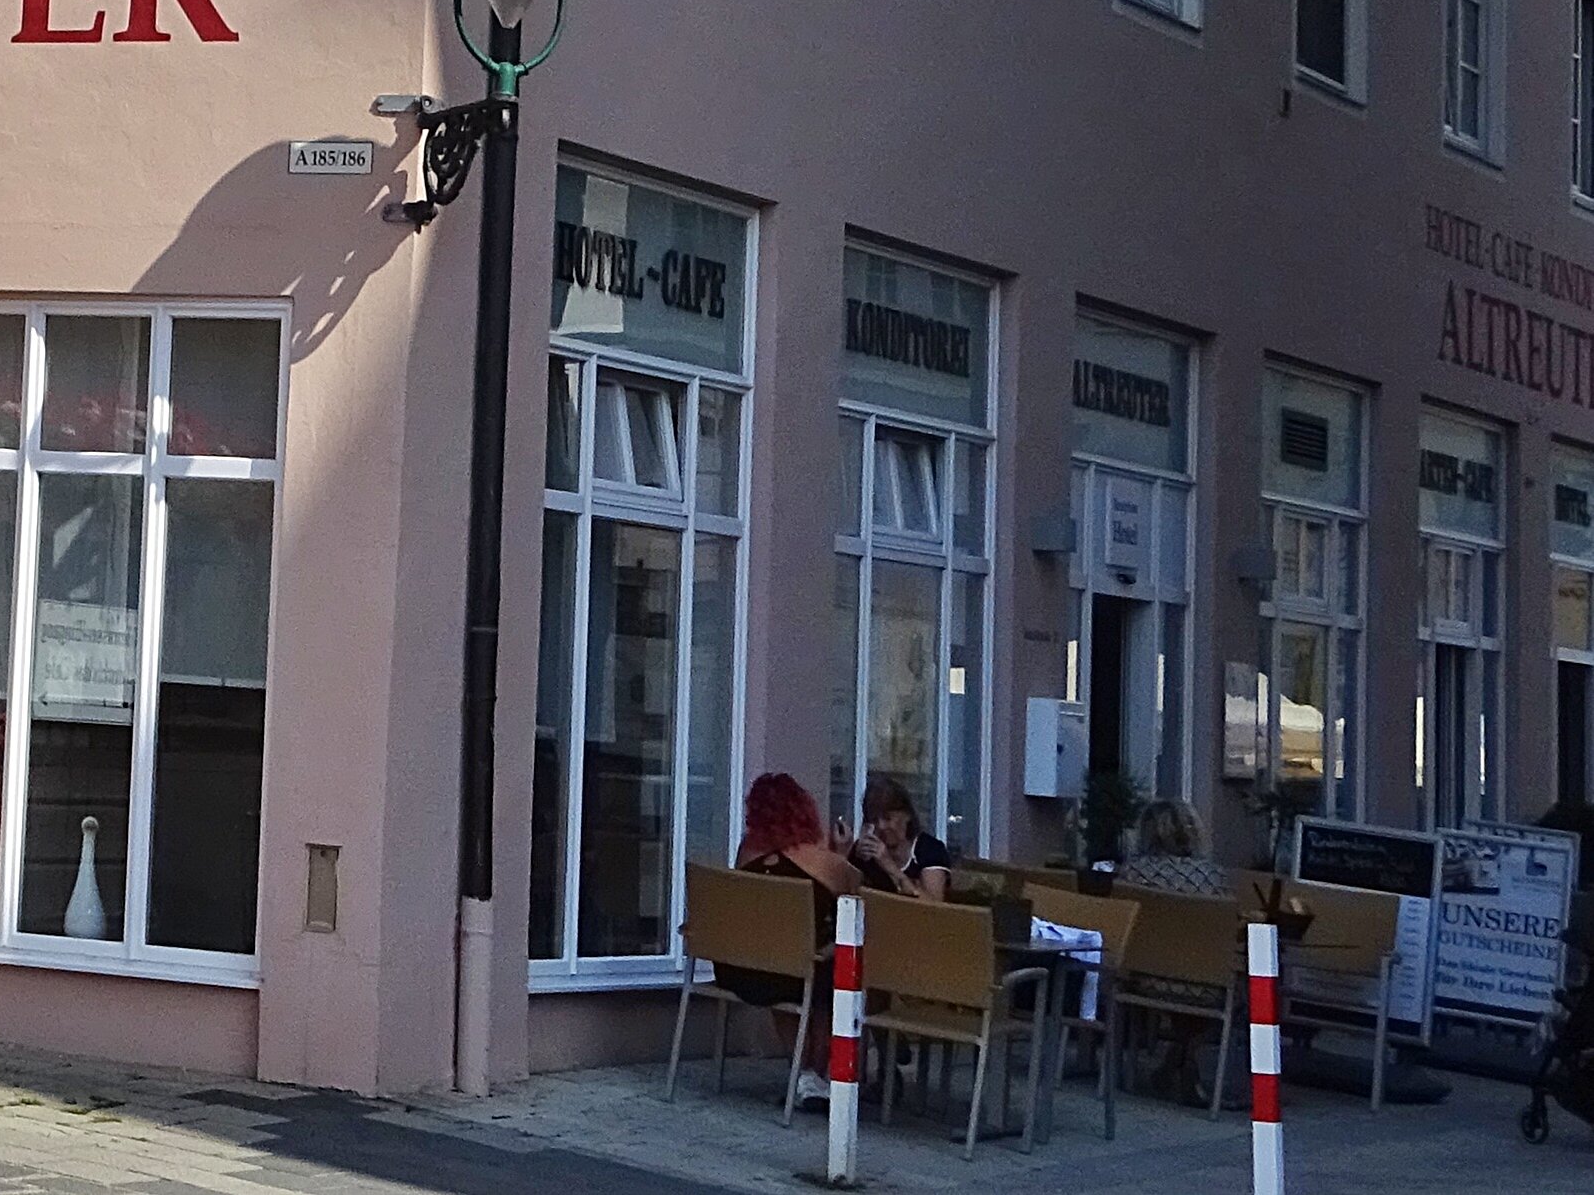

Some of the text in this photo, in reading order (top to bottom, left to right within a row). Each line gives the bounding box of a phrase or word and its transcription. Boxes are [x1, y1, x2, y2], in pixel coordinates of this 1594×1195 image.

[294, 149, 366, 167] A 185/186
[1437, 277, 1594, 410] ALTREUT
[1442, 902, 1561, 940] UNSERE
